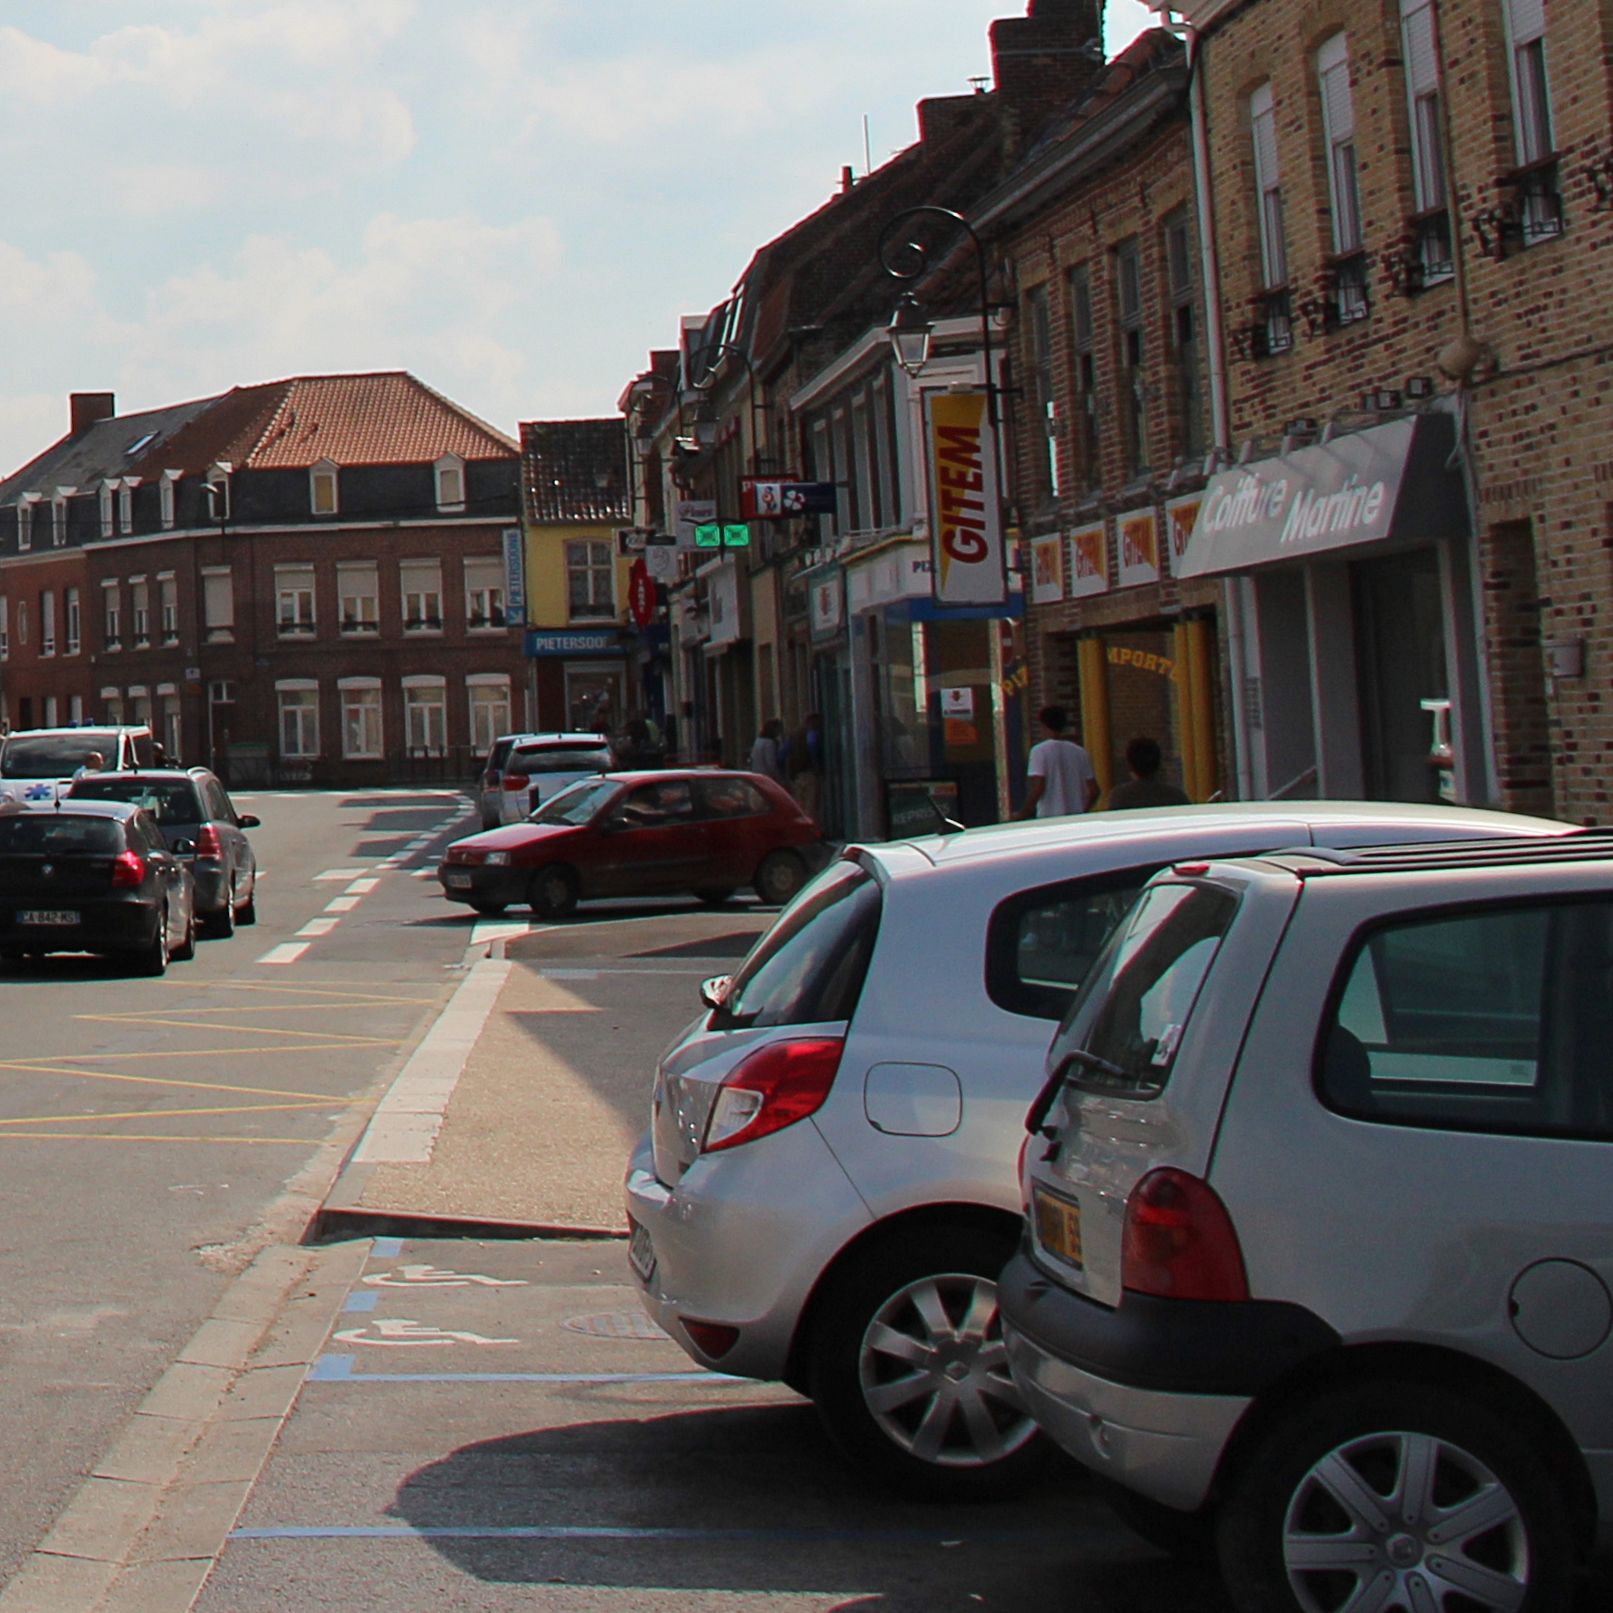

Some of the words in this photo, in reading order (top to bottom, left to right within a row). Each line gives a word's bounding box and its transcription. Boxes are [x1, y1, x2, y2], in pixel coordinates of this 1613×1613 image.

[936, 424, 990, 565] GITEM
[1203, 473, 1288, 534] Coiffure
[1280, 474, 1385, 543] Martine
